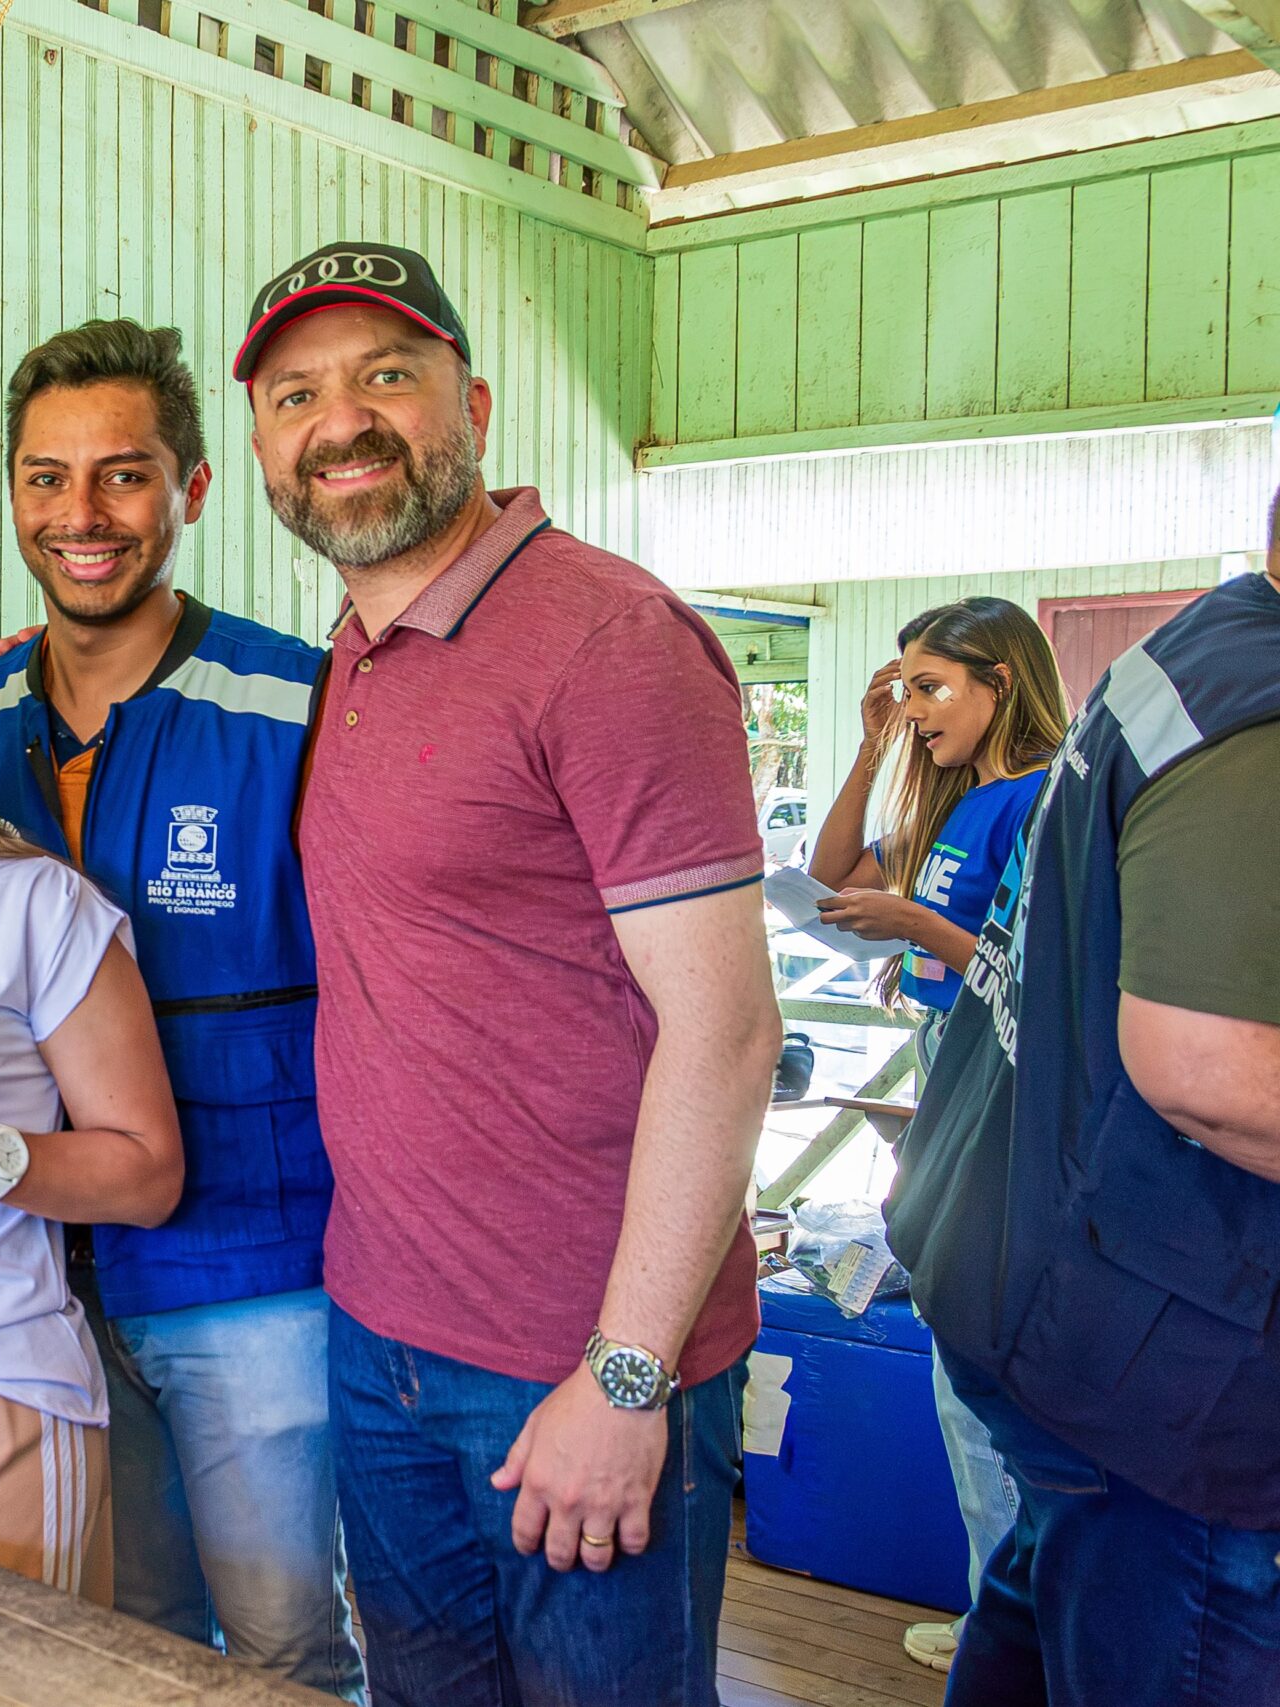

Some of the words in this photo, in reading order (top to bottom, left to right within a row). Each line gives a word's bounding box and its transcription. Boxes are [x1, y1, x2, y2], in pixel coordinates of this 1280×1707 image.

[147, 879, 219, 890] PREFEITURA
[147, 886, 172, 897] RIO
[176, 887, 236, 900] BRANCO
[195, 899, 235, 908] EMPREGO
[166, 905, 173, 914] E
[174, 906, 216, 916] DIGNIDADE
